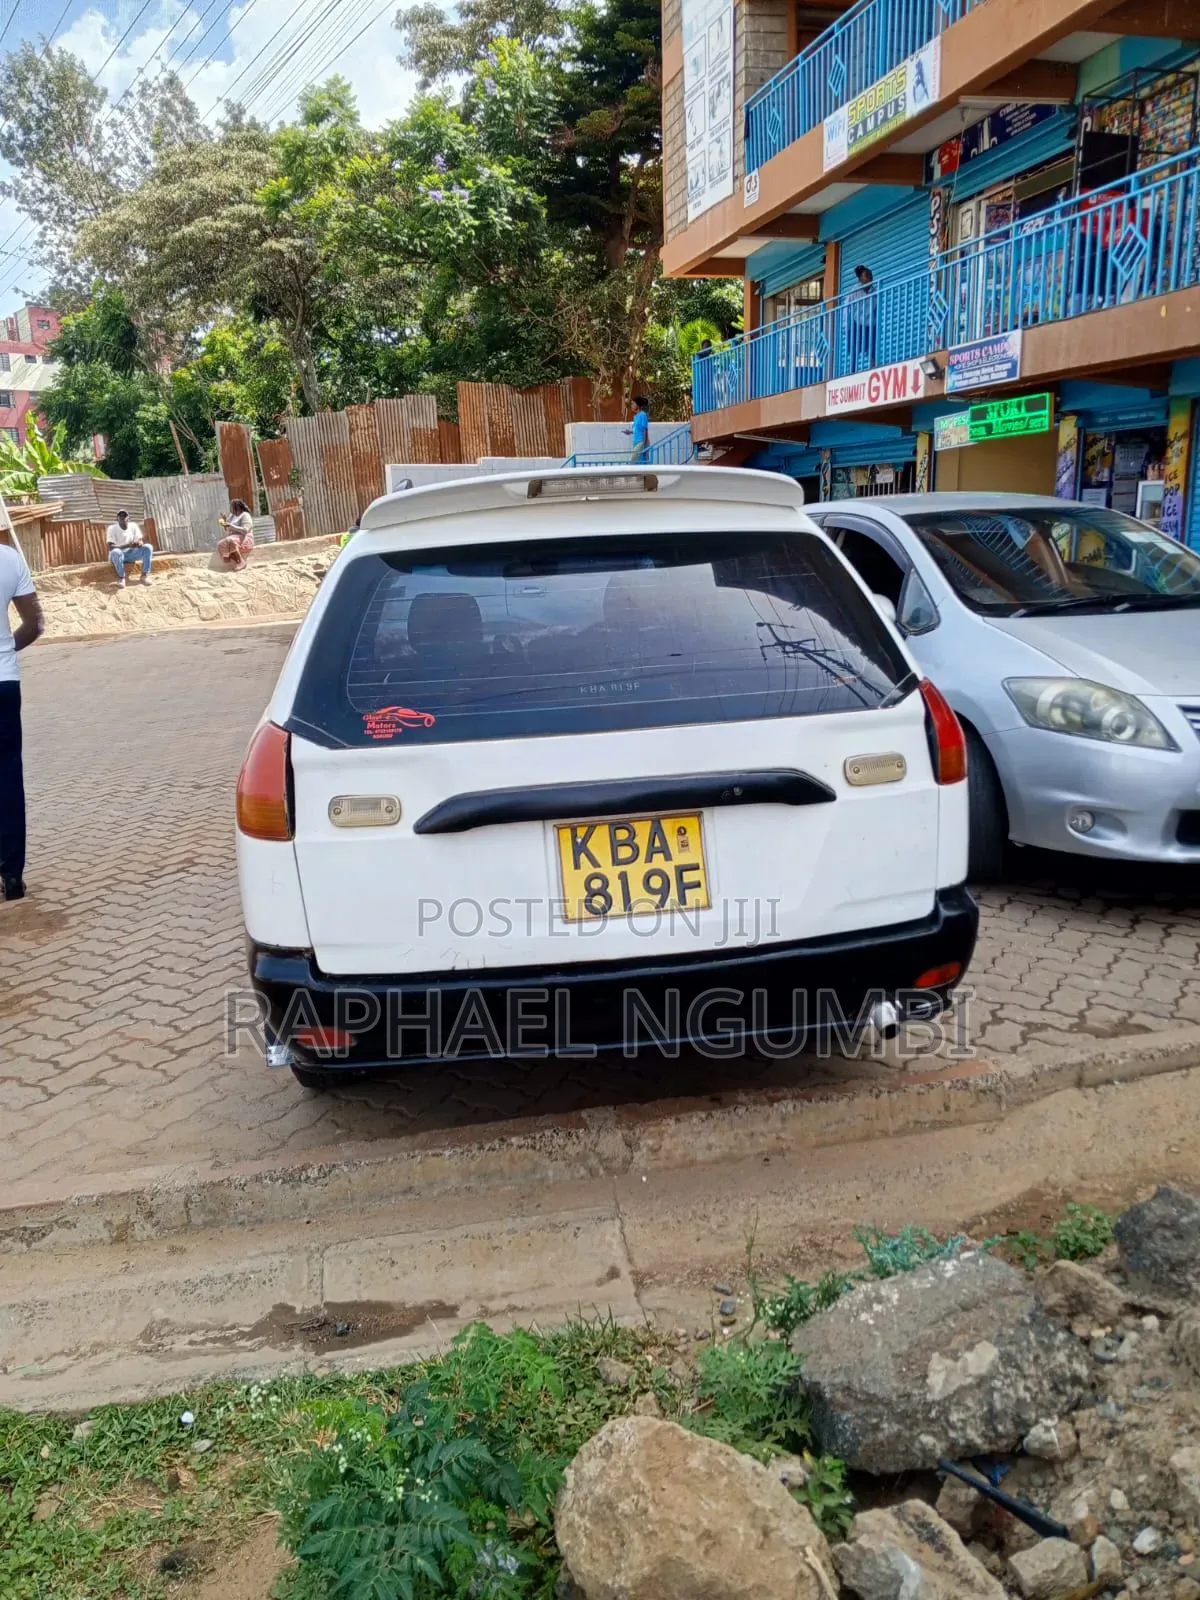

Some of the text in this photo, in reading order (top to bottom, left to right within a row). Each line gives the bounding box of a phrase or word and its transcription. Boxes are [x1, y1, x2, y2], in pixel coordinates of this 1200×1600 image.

[848, 65, 907, 127] SPORTS
[848, 94, 906, 145] CAMPUS
[949, 348, 980, 365] SPORTS
[828, 365, 908, 406] THE SUMMIT GYM
[570, 819, 673, 870] KBA
[584, 863, 701, 915] 819F
